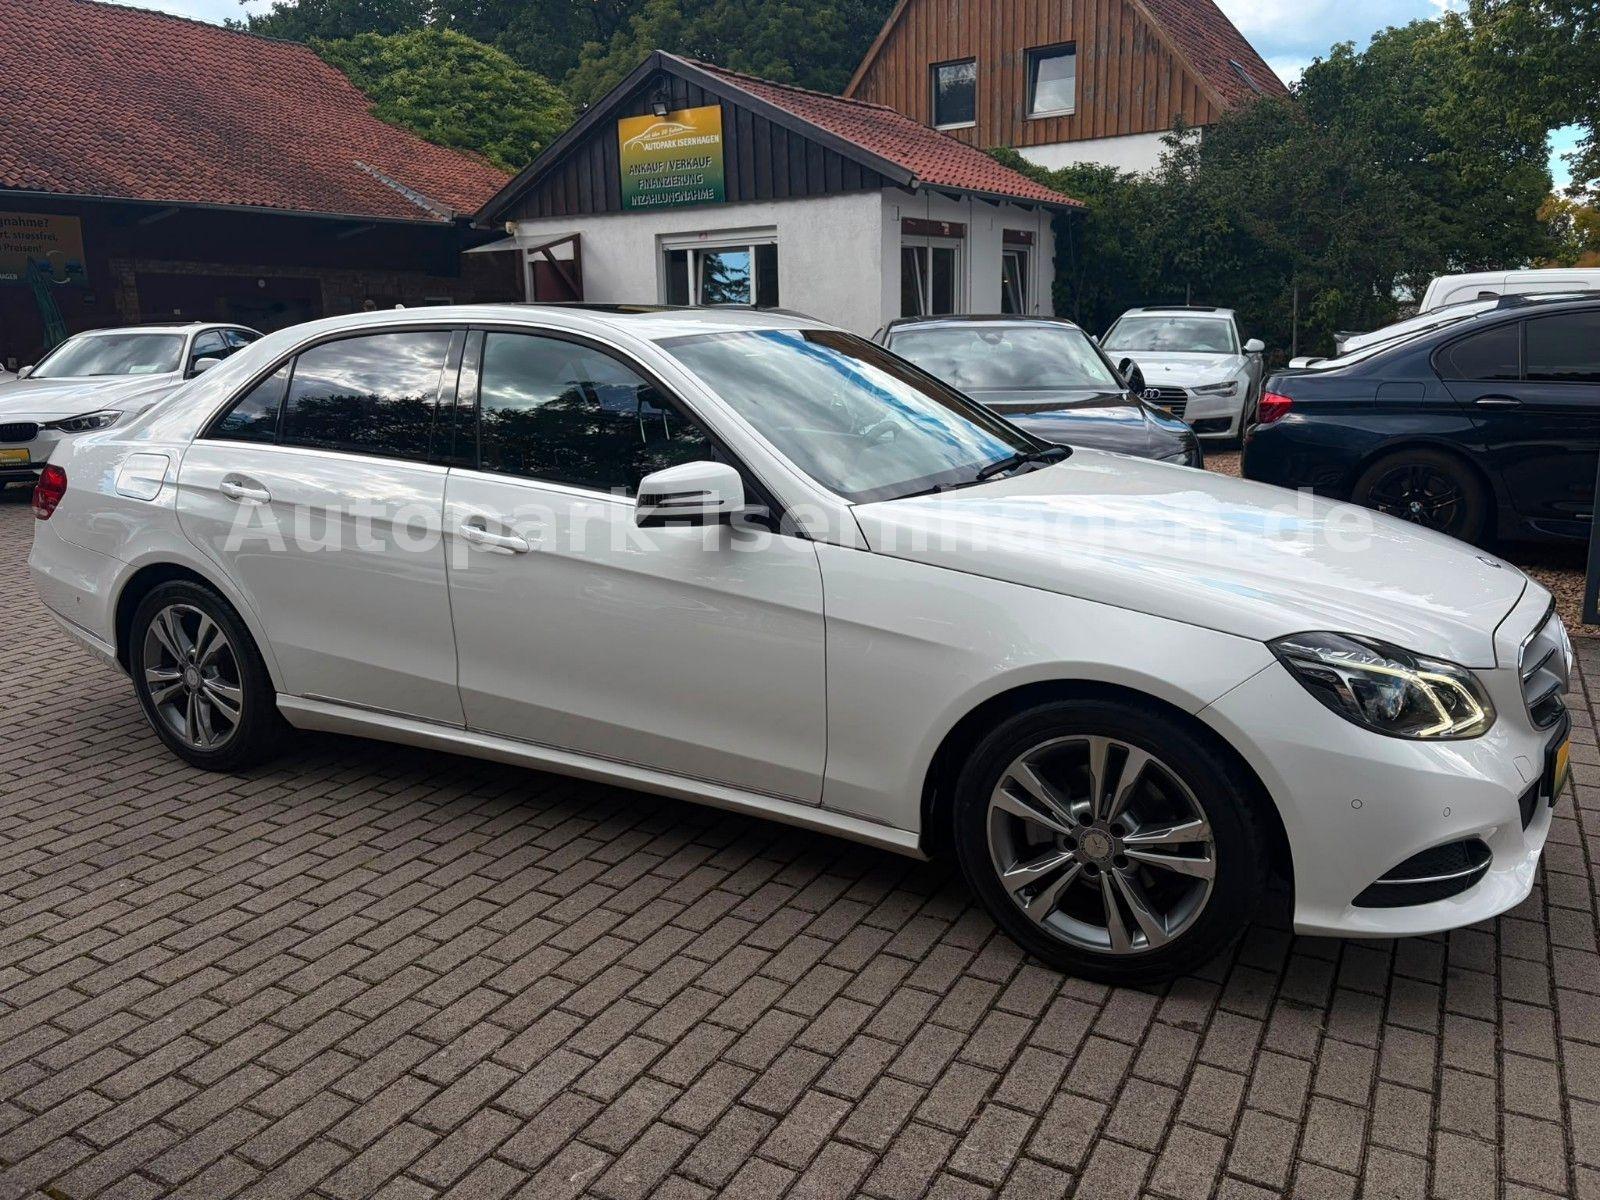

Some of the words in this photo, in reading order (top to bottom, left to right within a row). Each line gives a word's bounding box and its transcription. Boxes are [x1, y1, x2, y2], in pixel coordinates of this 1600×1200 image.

[644, 139, 677, 151] AUTOPARK
[677, 134, 720, 147] ISERNHAGEN
[629, 160, 664, 176] ANKAUF
[639, 174, 704, 190] FINANZIERUNG
